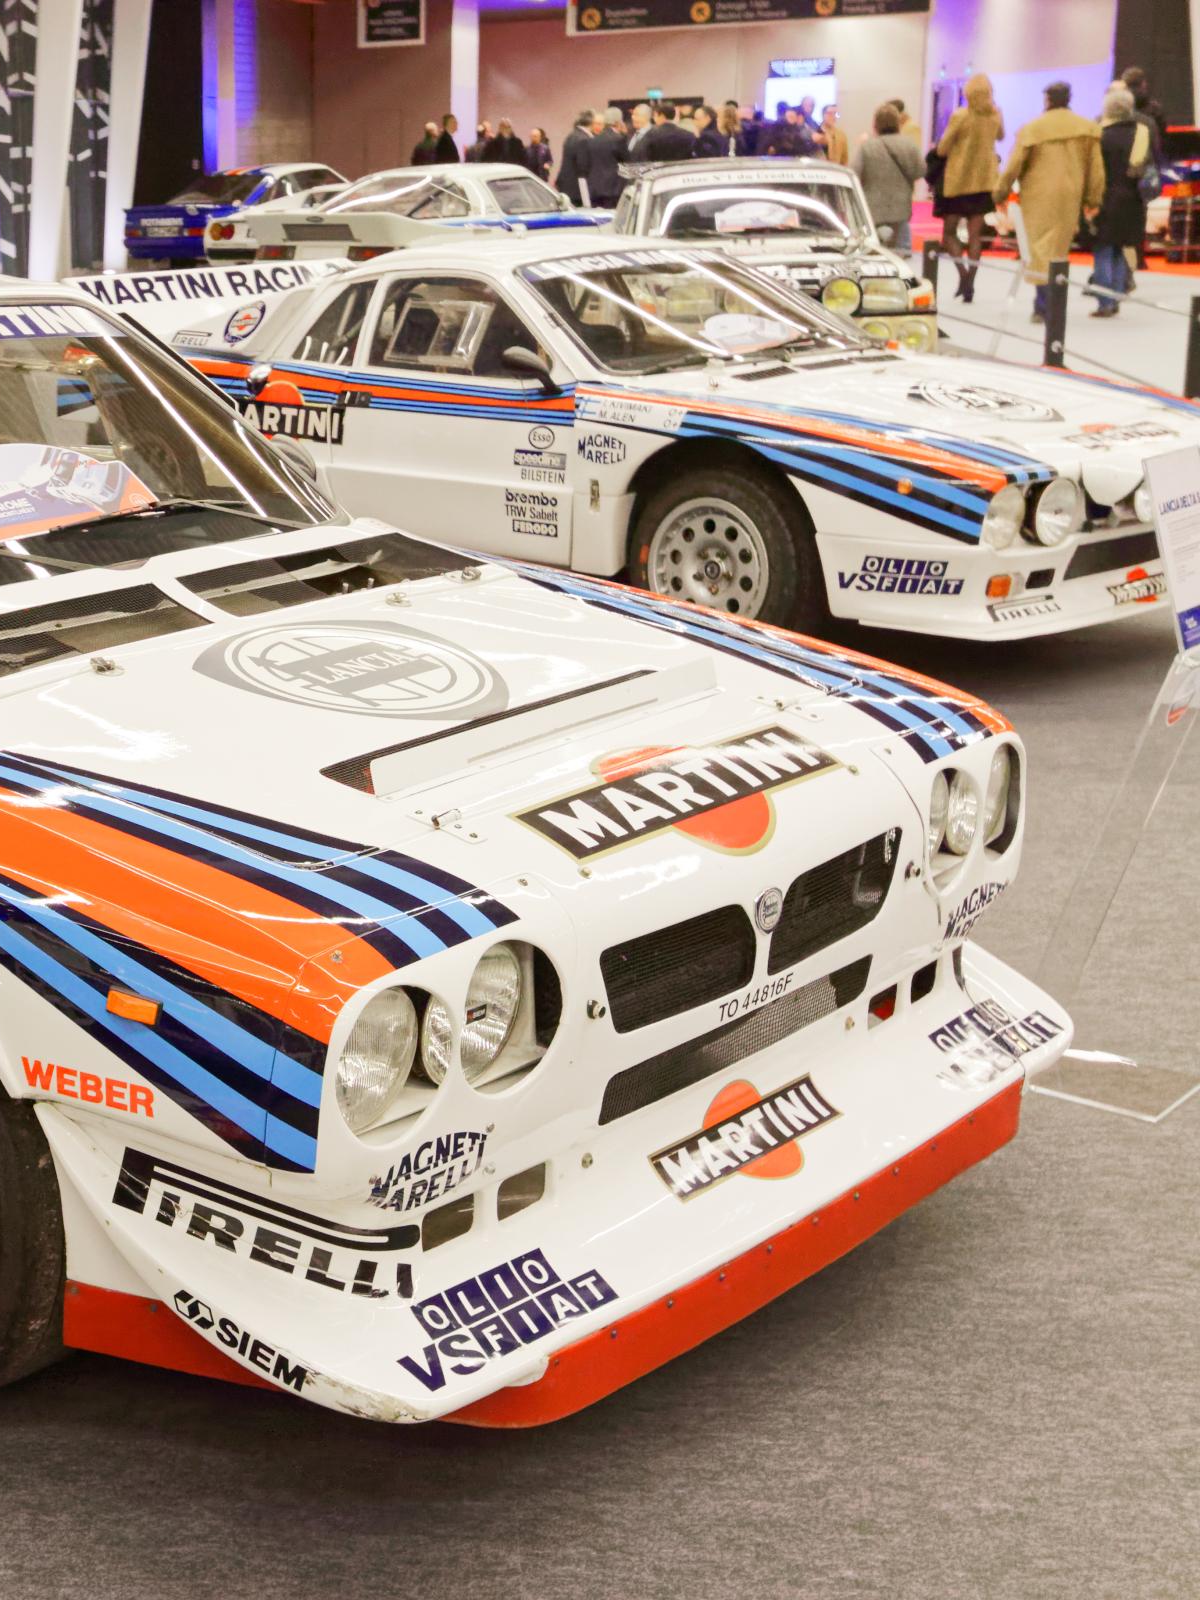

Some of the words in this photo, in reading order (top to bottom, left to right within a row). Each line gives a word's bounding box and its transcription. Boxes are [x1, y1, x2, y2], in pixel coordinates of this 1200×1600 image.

[79, 273, 223, 305] MARTINI
[243, 403, 340, 439] ARTINI
[612, 412, 636, 424] ALEN
[521, 470, 565, 484] BILSTEIN
[505, 489, 558, 506] brembo
[505, 504, 526, 519] TRW
[530, 506, 558, 522] Sabelt
[513, 521, 557, 537] FERODO
[864, 556, 947, 575] OLIO
[986, 595, 1061, 622] PIRELLI
[301, 648, 418, 687] LANCIA
[538, 731, 821, 849] MARTINI
[718, 996, 740, 1022] TO
[742, 972, 794, 1013] 44816F
[21, 1056, 154, 1118] WEBER
[659, 1082, 831, 1194] MARTINI
[112, 1146, 421, 1300] PIRELLI
[418, 1256, 556, 1335] OLIO
[215, 1317, 310, 1392] SIEM
